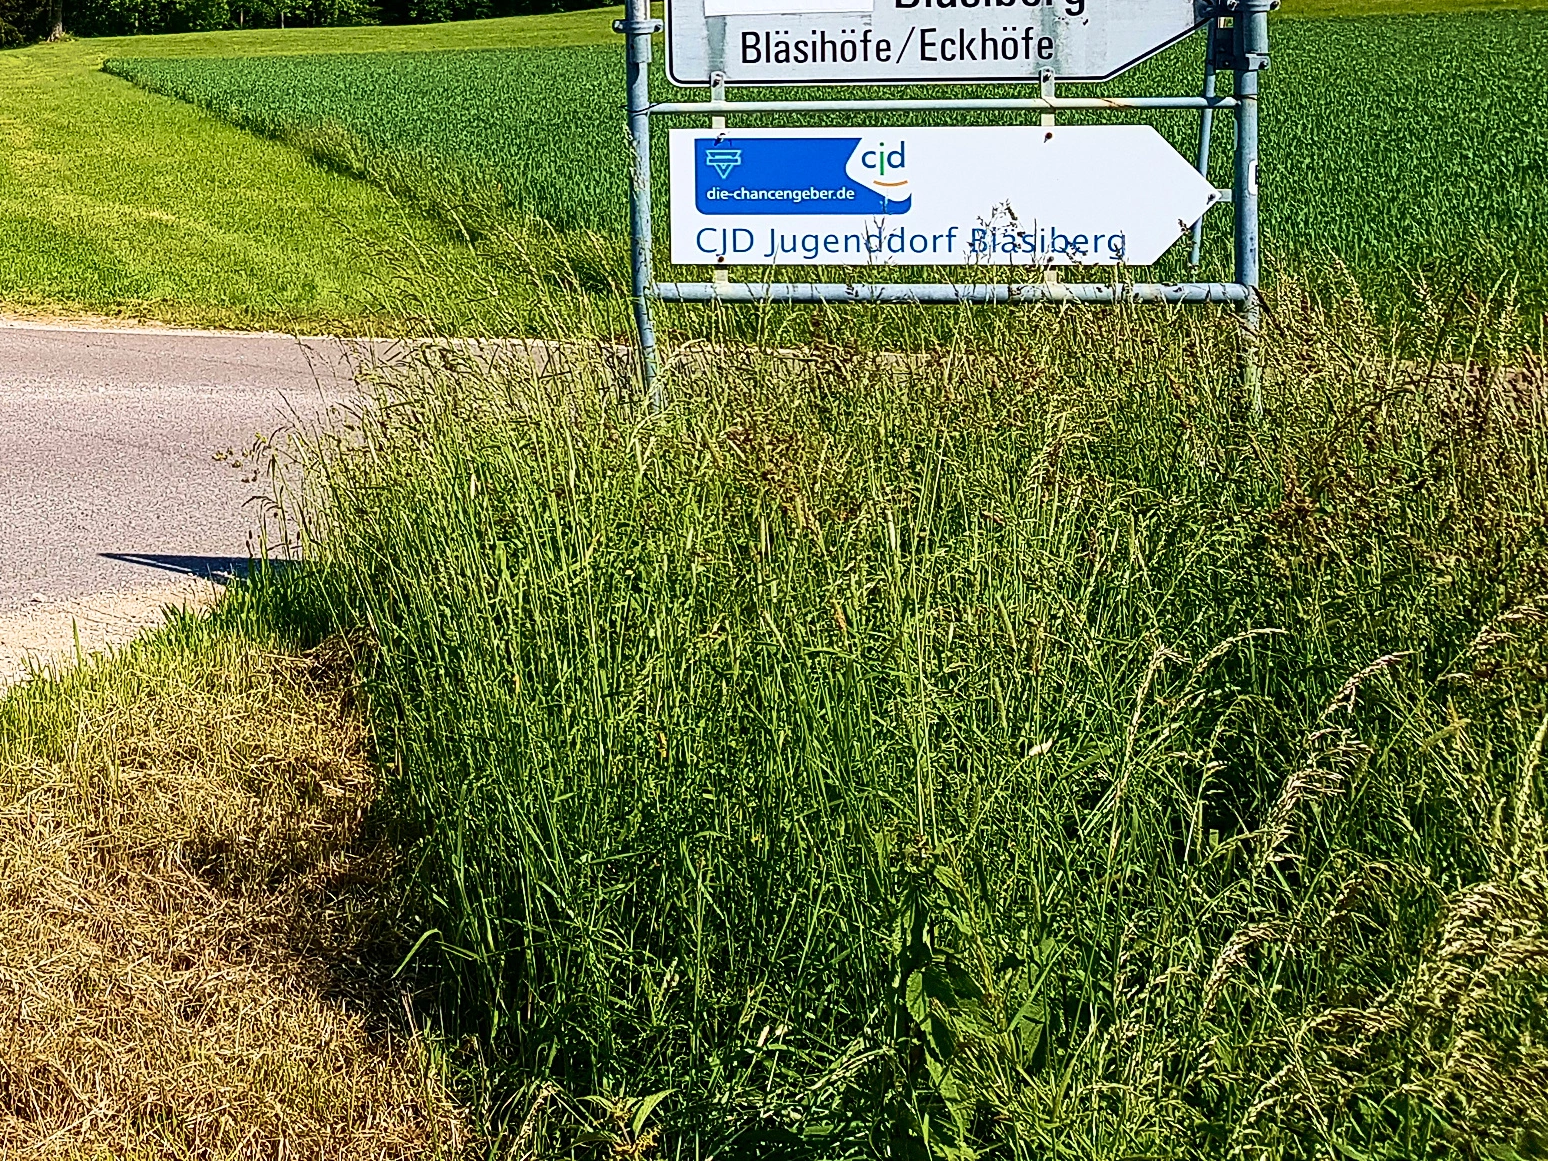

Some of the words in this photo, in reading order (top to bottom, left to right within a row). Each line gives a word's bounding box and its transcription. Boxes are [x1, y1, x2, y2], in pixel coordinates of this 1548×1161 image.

[860, 140, 906, 176] cjd
[706, 186, 856, 203] die-chancengeber.de
[695, 227, 755, 257] CJD
[763, 226, 959, 260] Jugenddorf
[970, 226, 1127, 260] Bläsiberg
